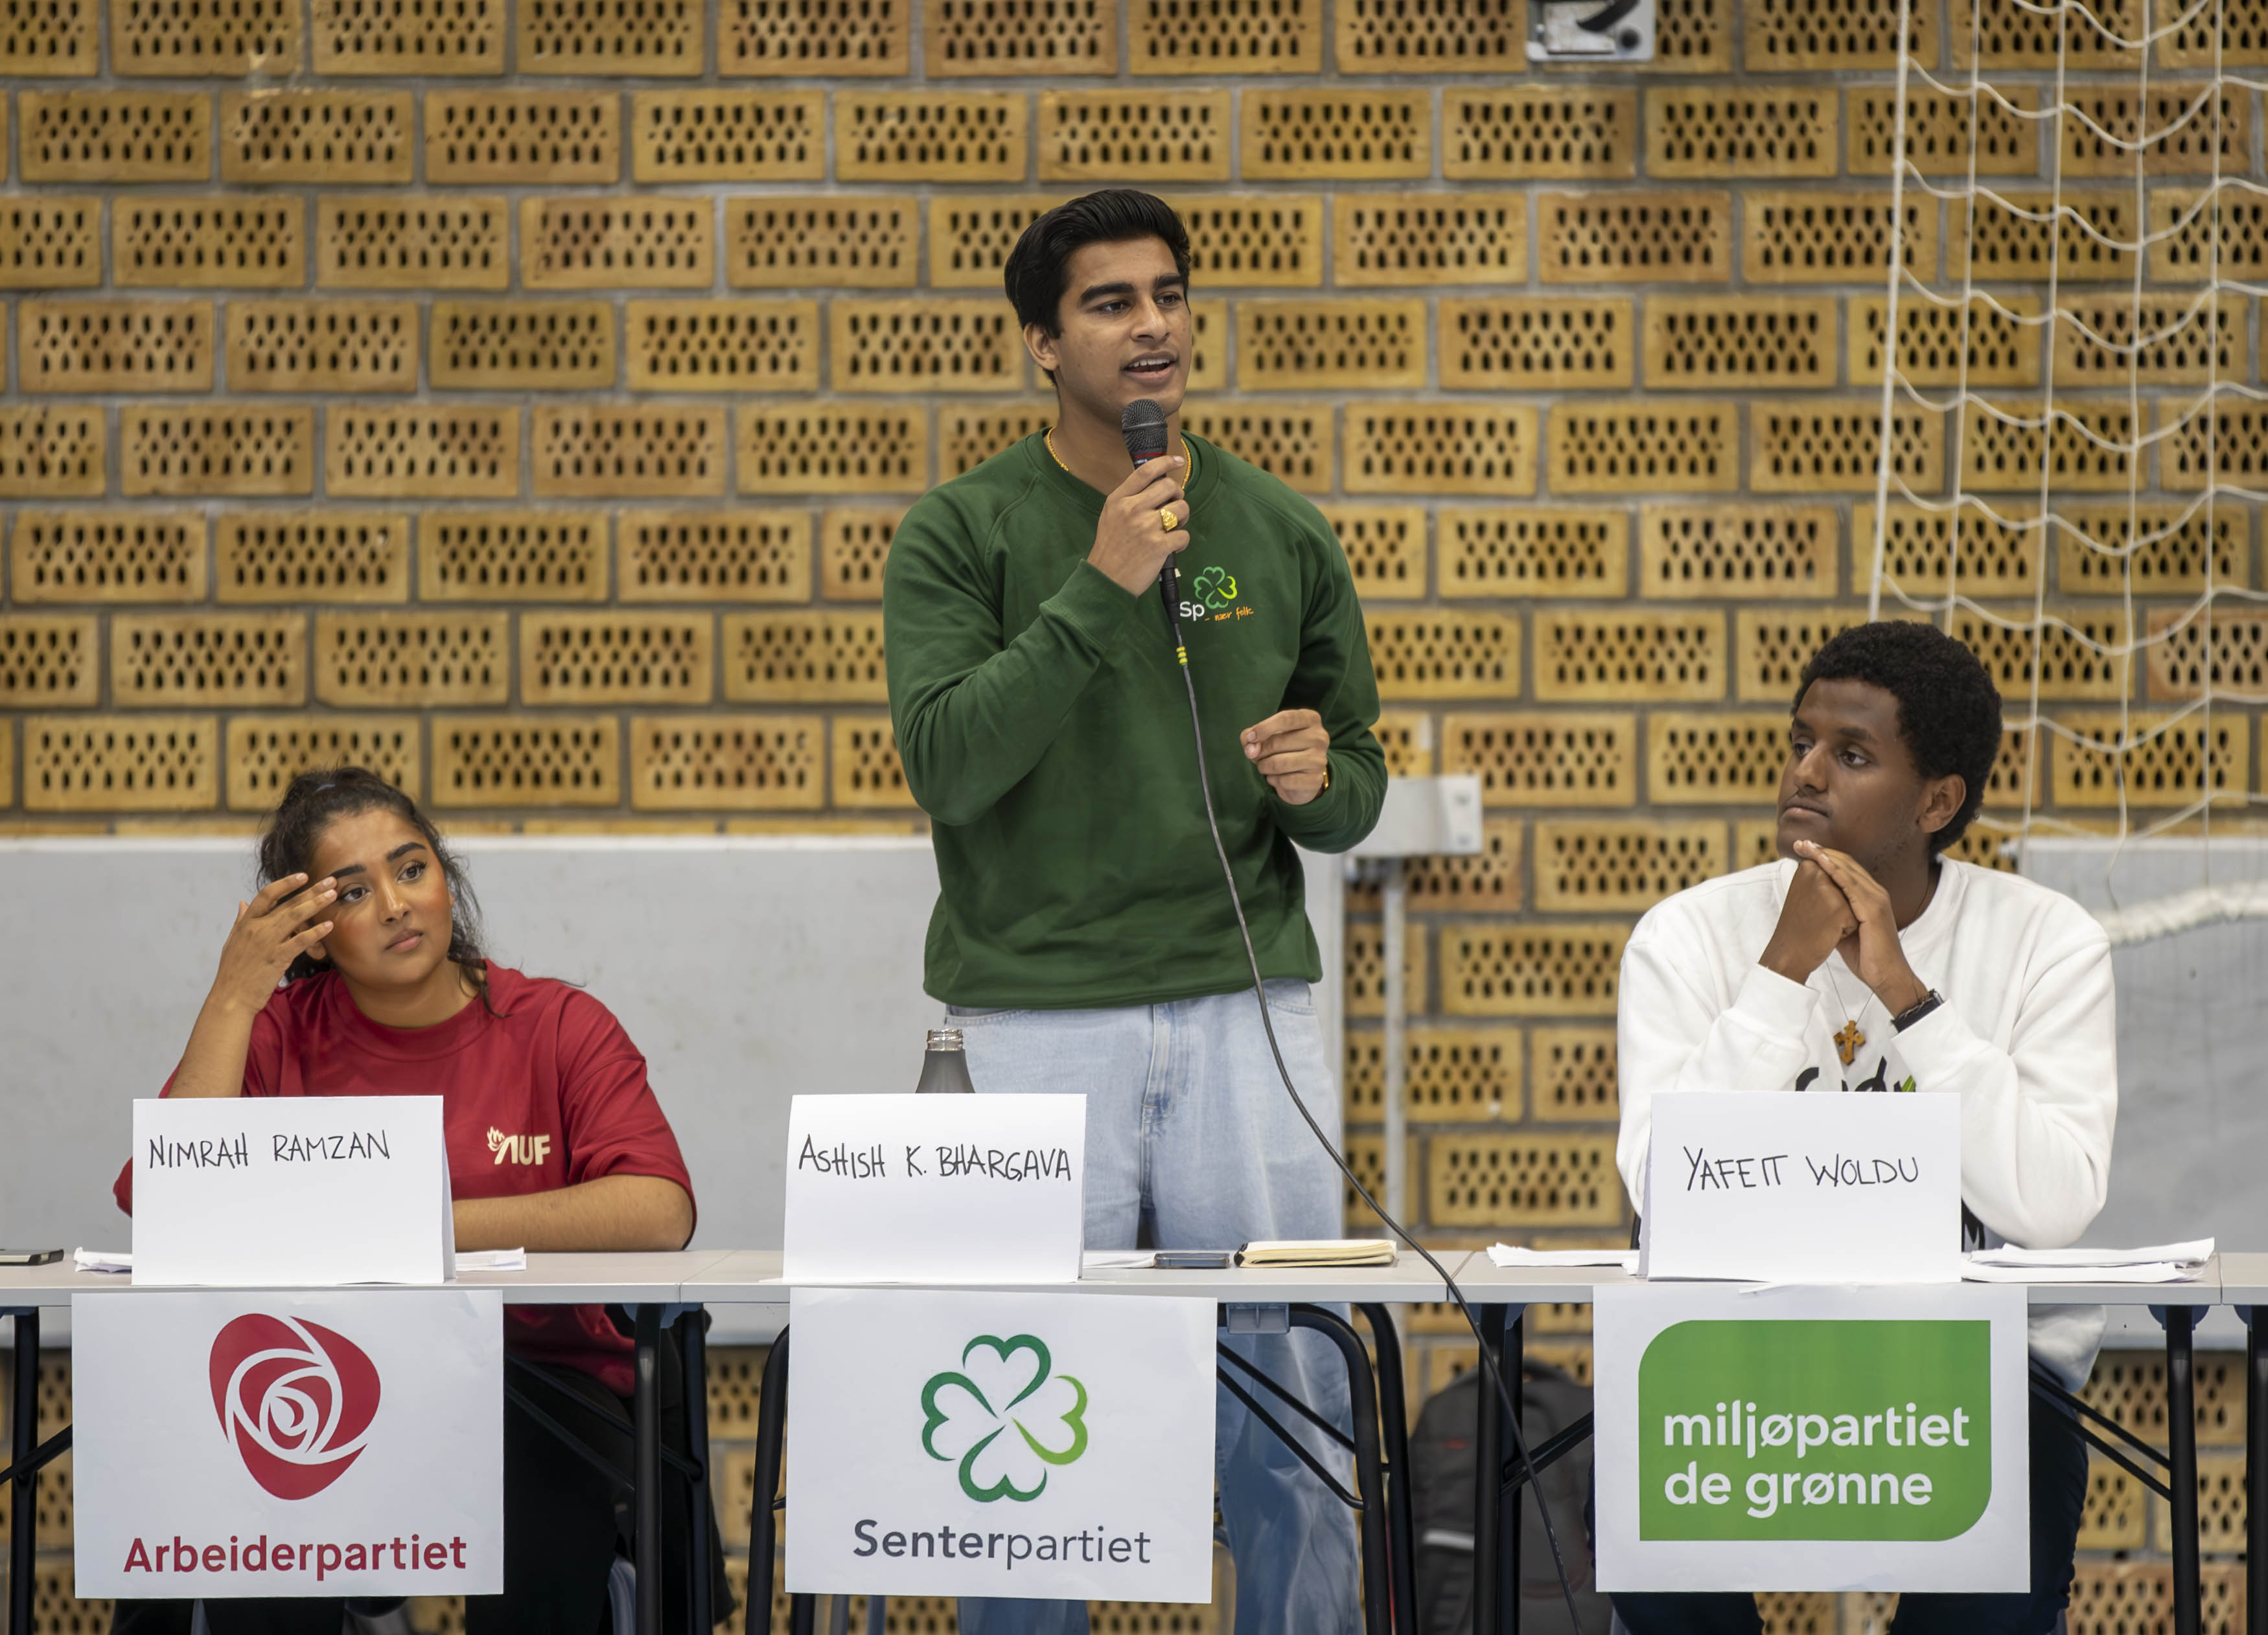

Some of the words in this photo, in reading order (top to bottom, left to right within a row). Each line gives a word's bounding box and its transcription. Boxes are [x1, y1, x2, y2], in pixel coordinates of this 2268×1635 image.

[1179, 601, 1205, 621] Sp
[1236, 606, 1254, 621] folk
[150, 1132, 248, 1169] NIMRAH
[272, 1130, 390, 1162] RAMZAN
[494, 1135, 551, 1166] AUF
[798, 1134, 886, 1179] ASHISH
[906, 1145, 927, 1177] K.
[936, 1144, 1071, 1182] BHARGAVA
[1683, 1146, 1788, 1191] YAFEIT
[1805, 1154, 1919, 1187] WOLDU
[1664, 1399, 1969, 1459] miljøpartiet
[1664, 1461, 1731, 1505] de
[1745, 1472, 1933, 1518] grønne
[123, 1534, 467, 1582] Arbeiderpartiet
[853, 1519, 1151, 1570] Senterpartiet
